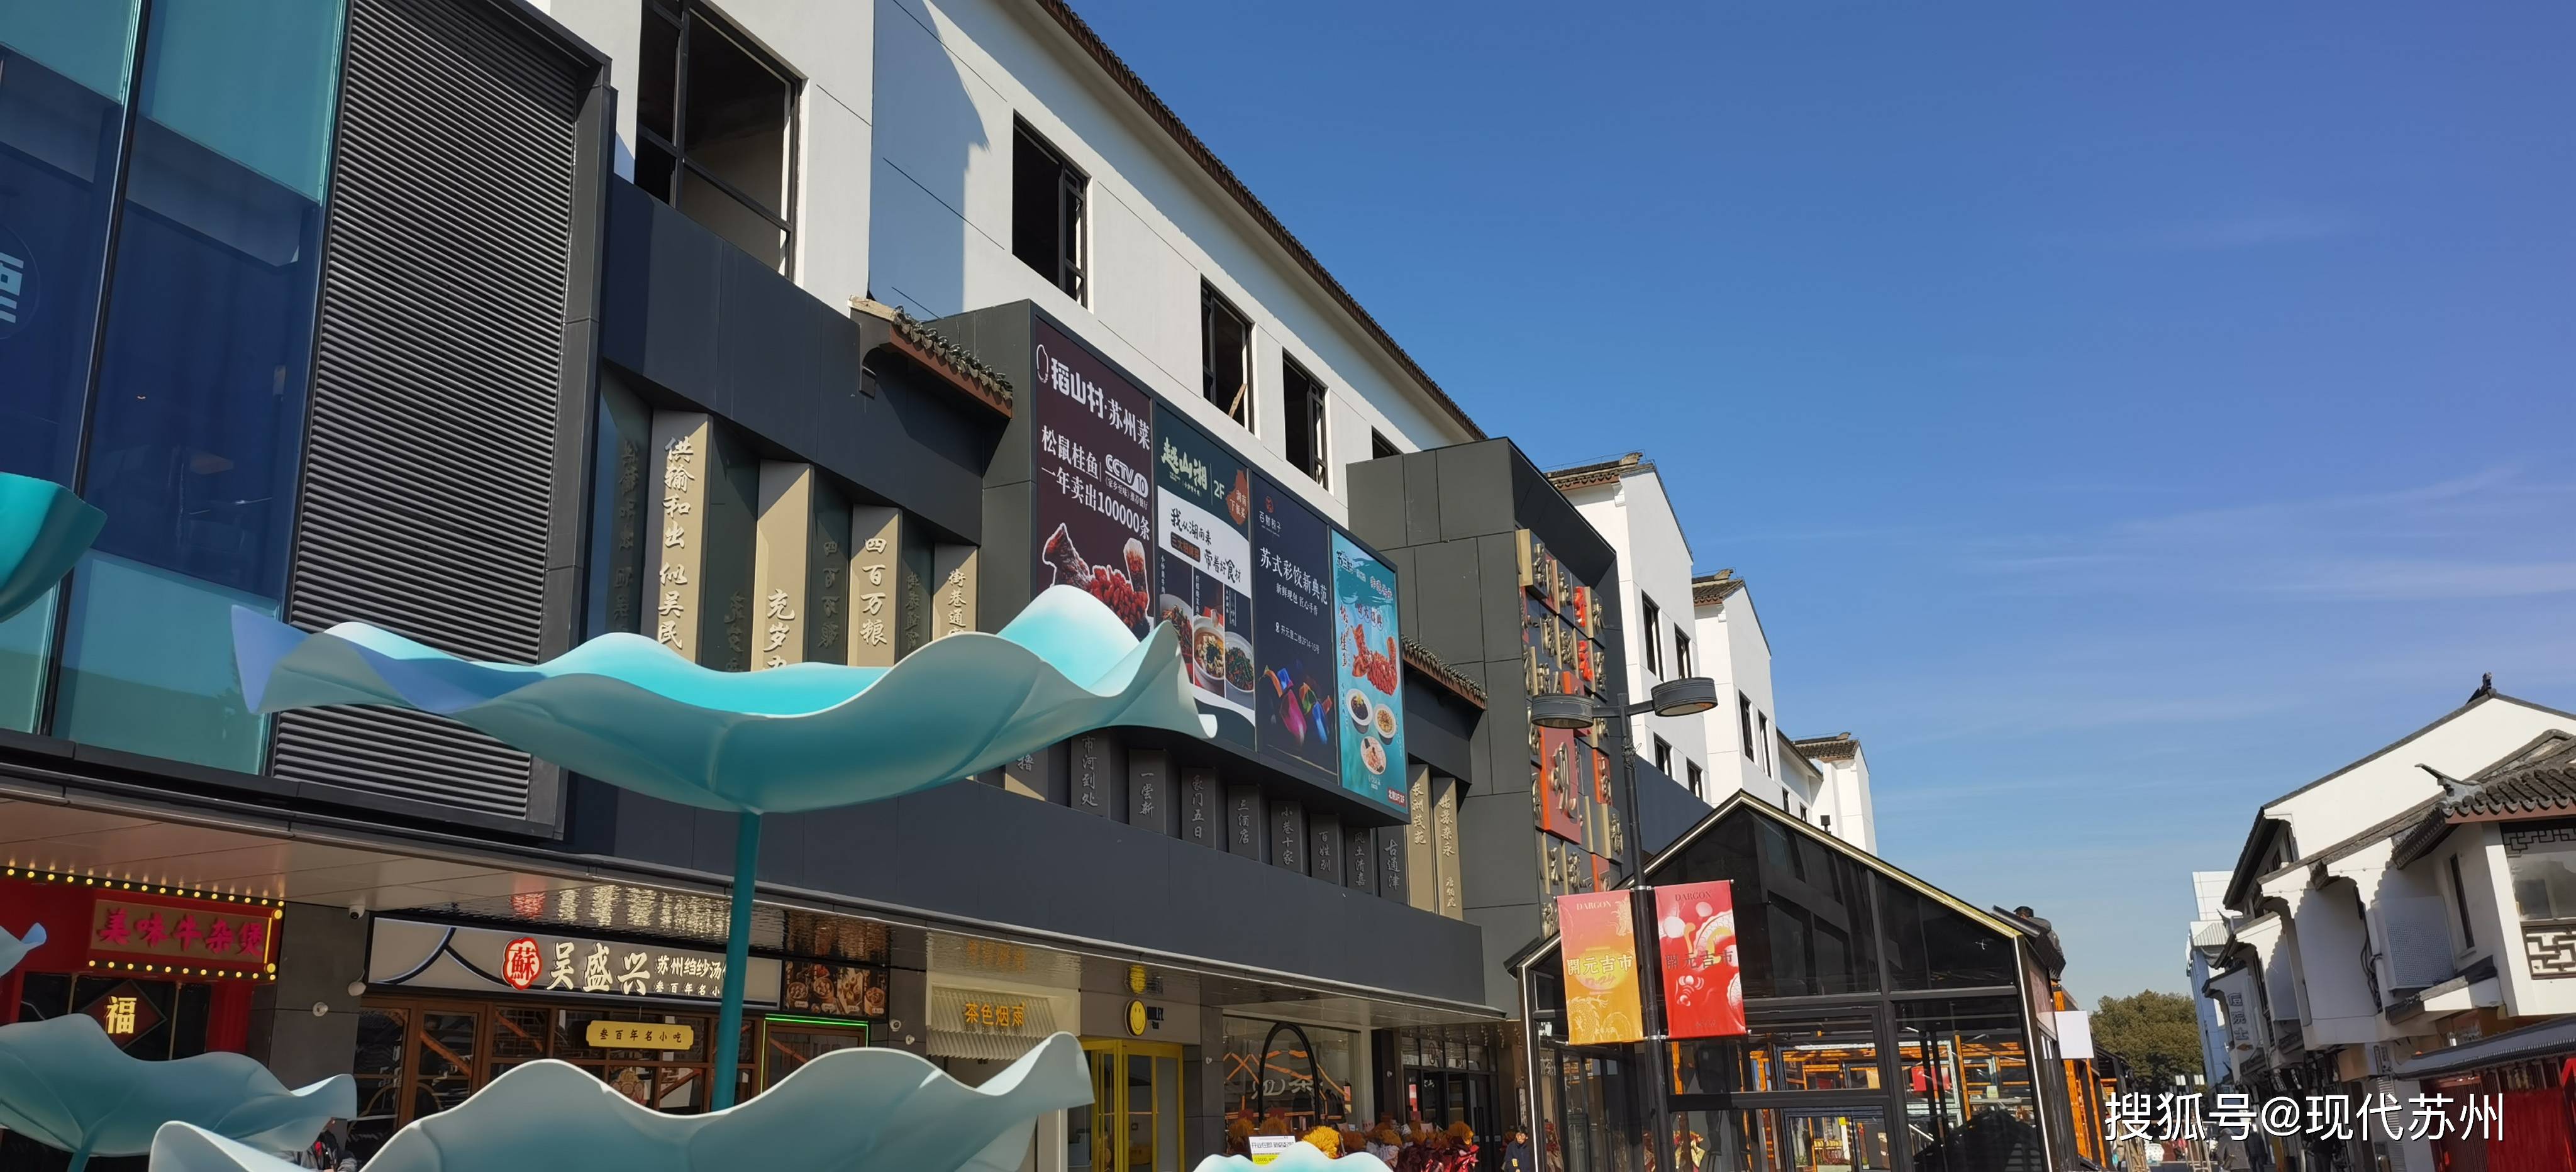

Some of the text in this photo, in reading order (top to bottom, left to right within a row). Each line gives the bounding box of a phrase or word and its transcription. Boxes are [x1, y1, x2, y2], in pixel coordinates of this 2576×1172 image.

[1041, 425, 1099, 480] 松鼠桂鱼
[1105, 454, 1134, 484] CCTV
[1041, 467, 1150, 541] 一年卖出100000条
[1213, 480, 1225, 500] 2F
[1170, 507, 1212, 546] 我从湖南来
[1204, 548, 1241, 583] 带着好食材
[1260, 546, 1328, 605] 苏式彩饺新典范
[860, 538, 887, 646] 四百万粮
[1081, 736, 1098, 807] 市河到处
[1384, 838, 1401, 890] 古通津
[1576, 900, 1612, 911] DARGON
[1675, 890, 1712, 902] DARGON
[98, 908, 264, 956] 美味牛杂煲
[545, 941, 652, 996] 吴盛兴
[656, 954, 726, 981] 苏州绉纱汤
[1566, 954, 1633, 976] 開元吉市
[1665, 949, 1734, 972] 開元吉市
[106, 996, 137, 1034] 福
[965, 1001, 1026, 1027] 茶色烟雨
[599, 1027, 682, 1044] 叁百年名小吃
